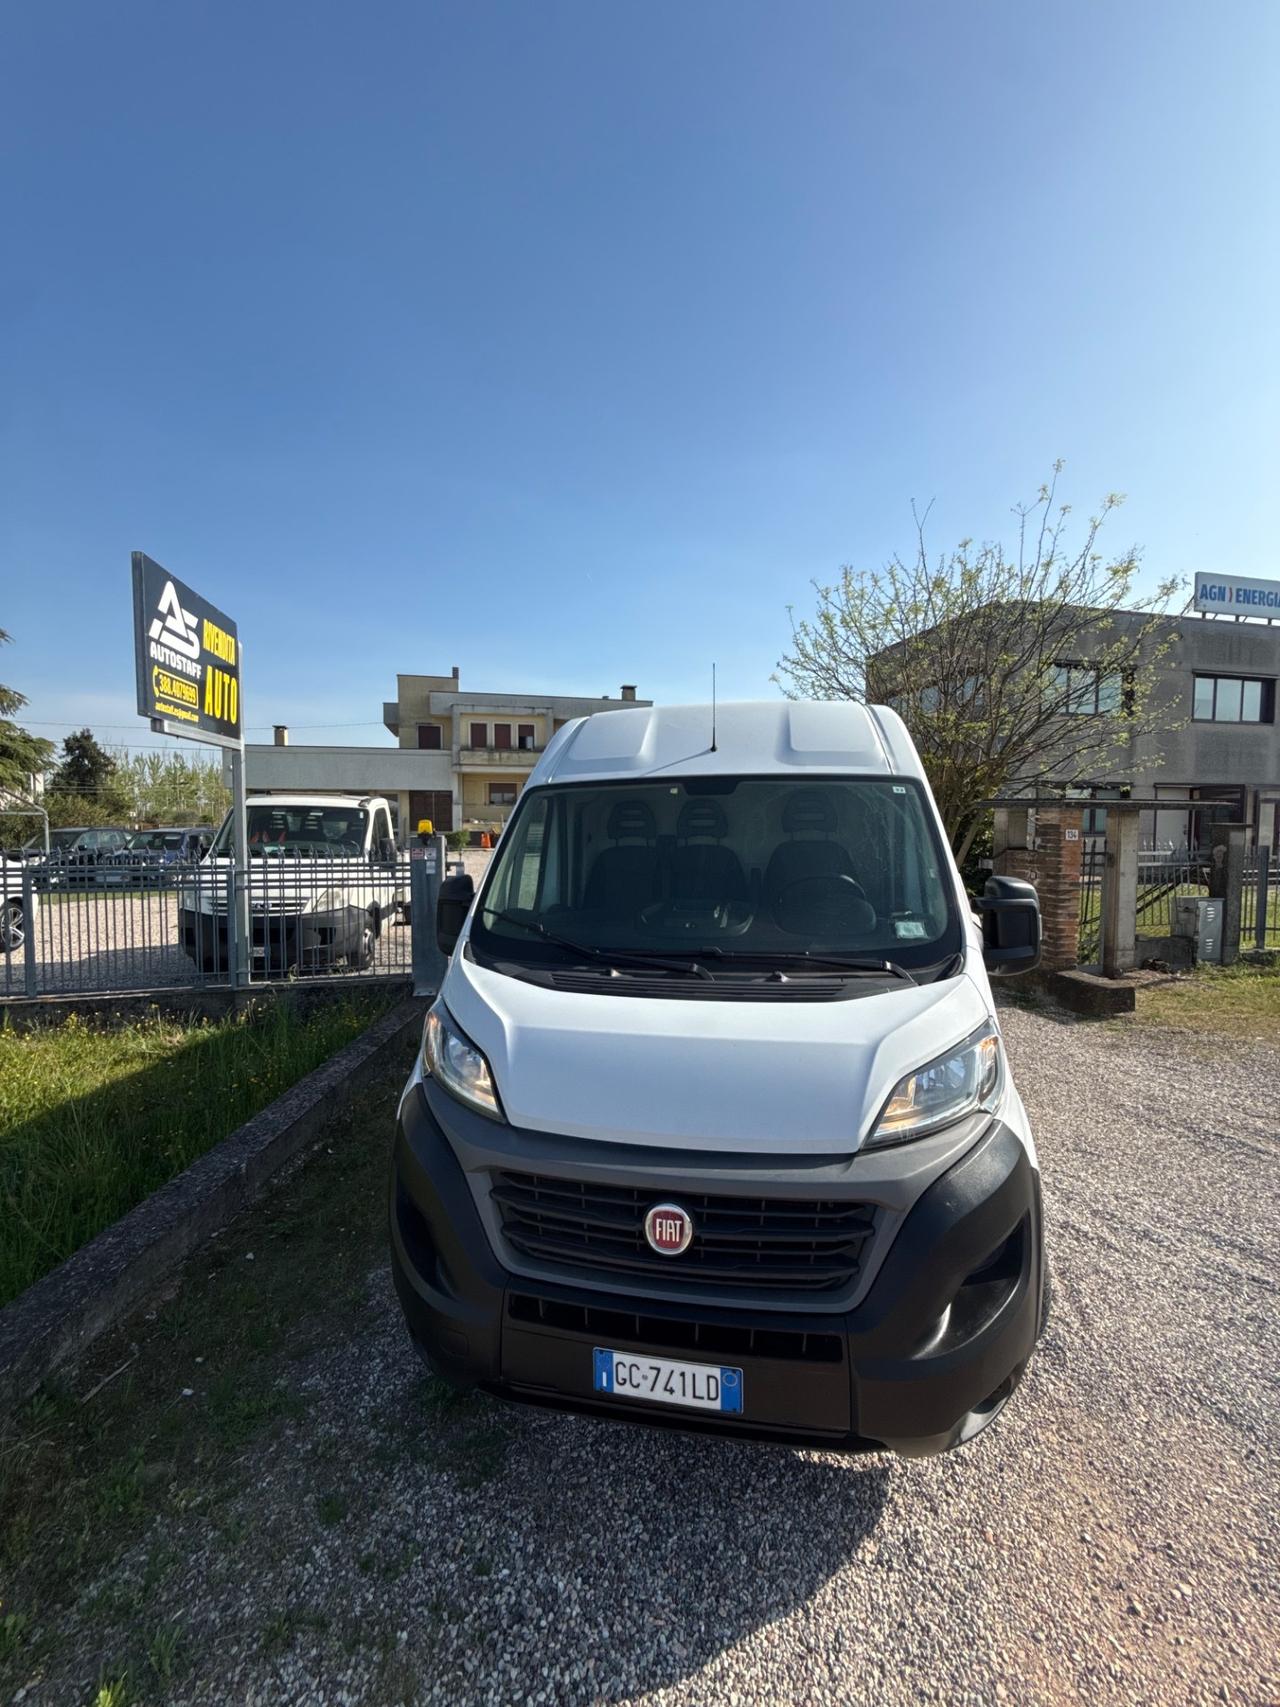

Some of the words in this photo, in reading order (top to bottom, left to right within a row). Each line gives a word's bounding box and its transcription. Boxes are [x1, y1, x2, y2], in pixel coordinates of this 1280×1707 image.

[1199, 584, 1227, 603] AGN
[1235, 587, 1280, 608] ENERGI
[150, 640, 202, 679] AUTOSTAFF
[203, 618, 236, 667] RIVENDITA
[204, 665, 238, 725] AUTO
[655, 1218, 682, 1242] FIAT
